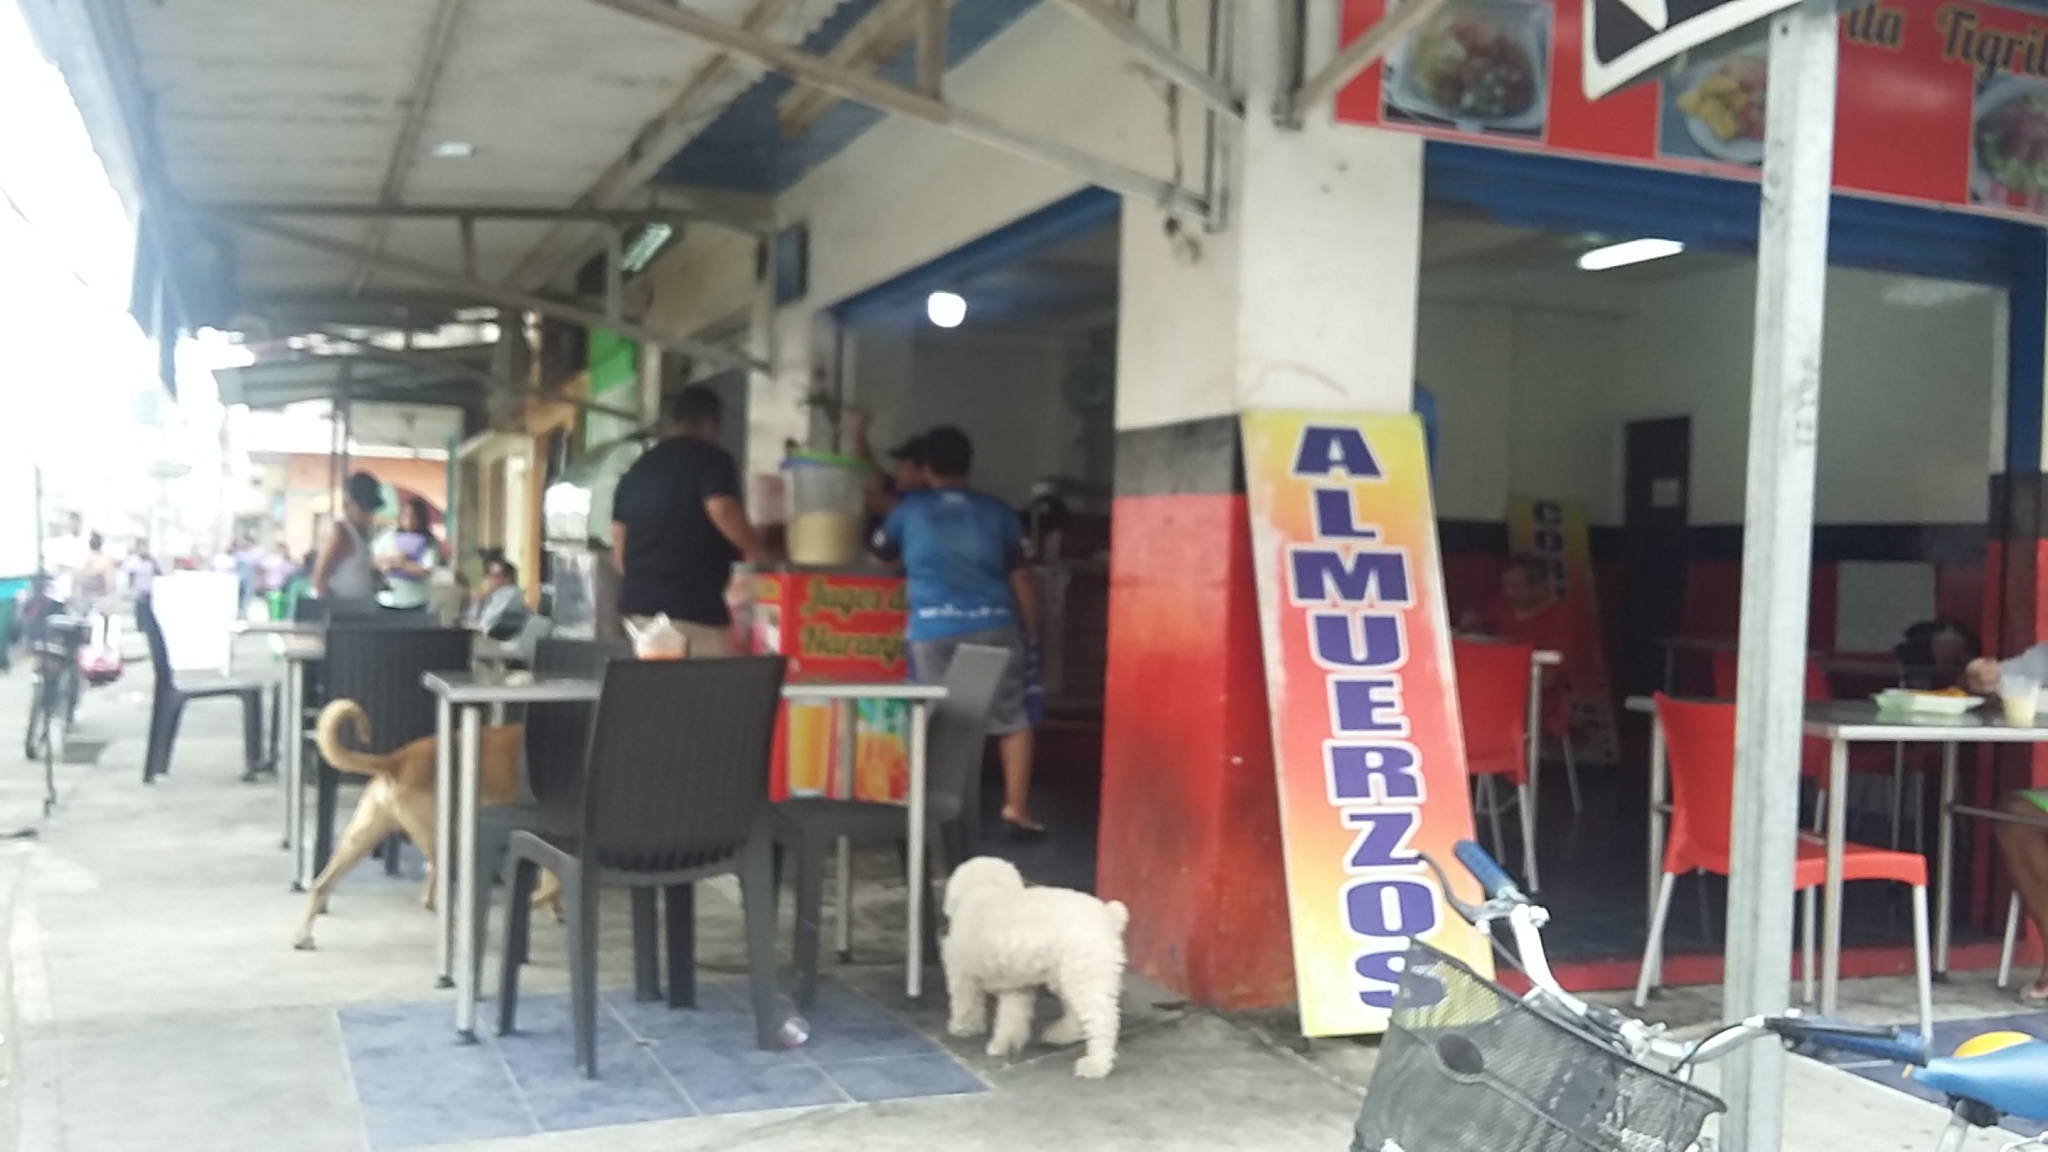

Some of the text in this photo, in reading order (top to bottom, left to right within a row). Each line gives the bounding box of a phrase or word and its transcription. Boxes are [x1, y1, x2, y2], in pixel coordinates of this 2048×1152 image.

[1938, 7, 2048, 92] Tigril
[802, 625, 908, 666] Naranj
[1291, 425, 1446, 1010] ALMUERZOS
